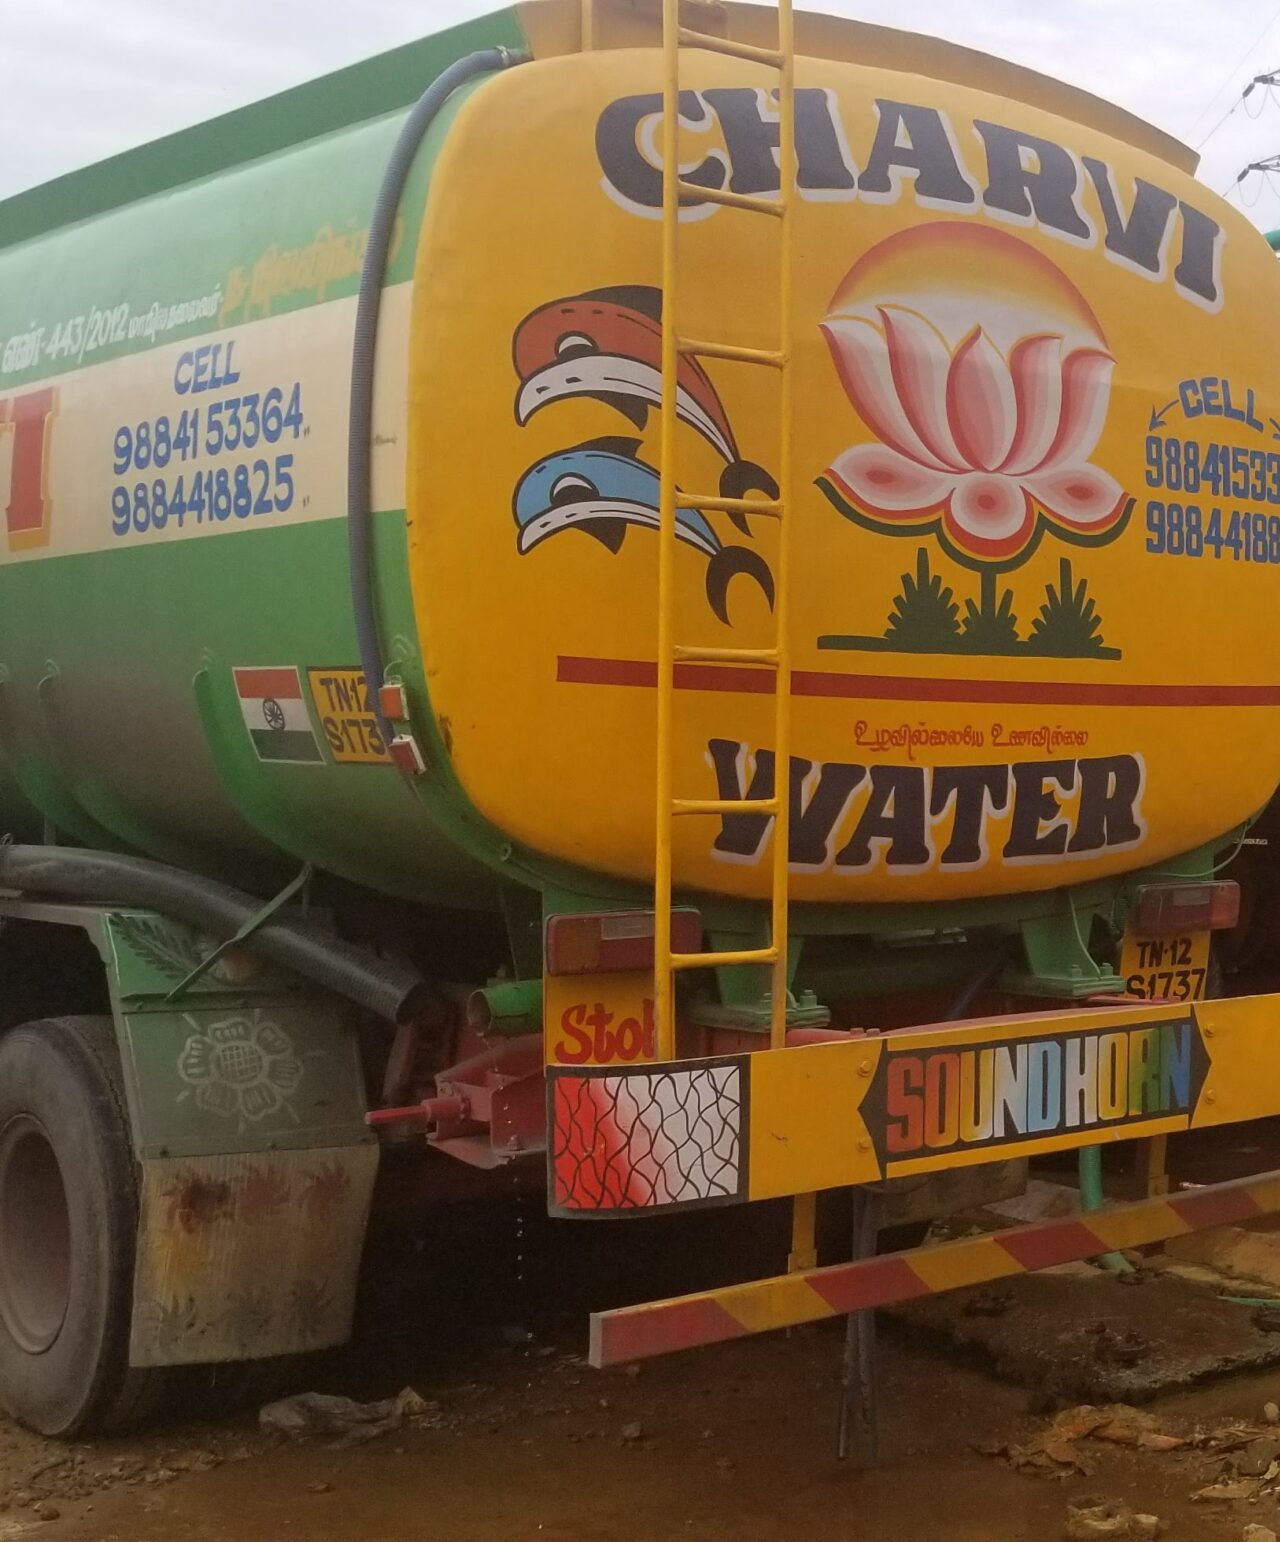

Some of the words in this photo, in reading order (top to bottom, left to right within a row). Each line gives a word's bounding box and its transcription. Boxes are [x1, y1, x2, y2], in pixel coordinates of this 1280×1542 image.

[595, 87, 1223, 308] CHARVI
[174, 341, 240, 395] CELL
[1178, 376, 1264, 433] CELL
[111, 454, 294, 535] 9884418825
[705, 738, 1144, 870] WATER
